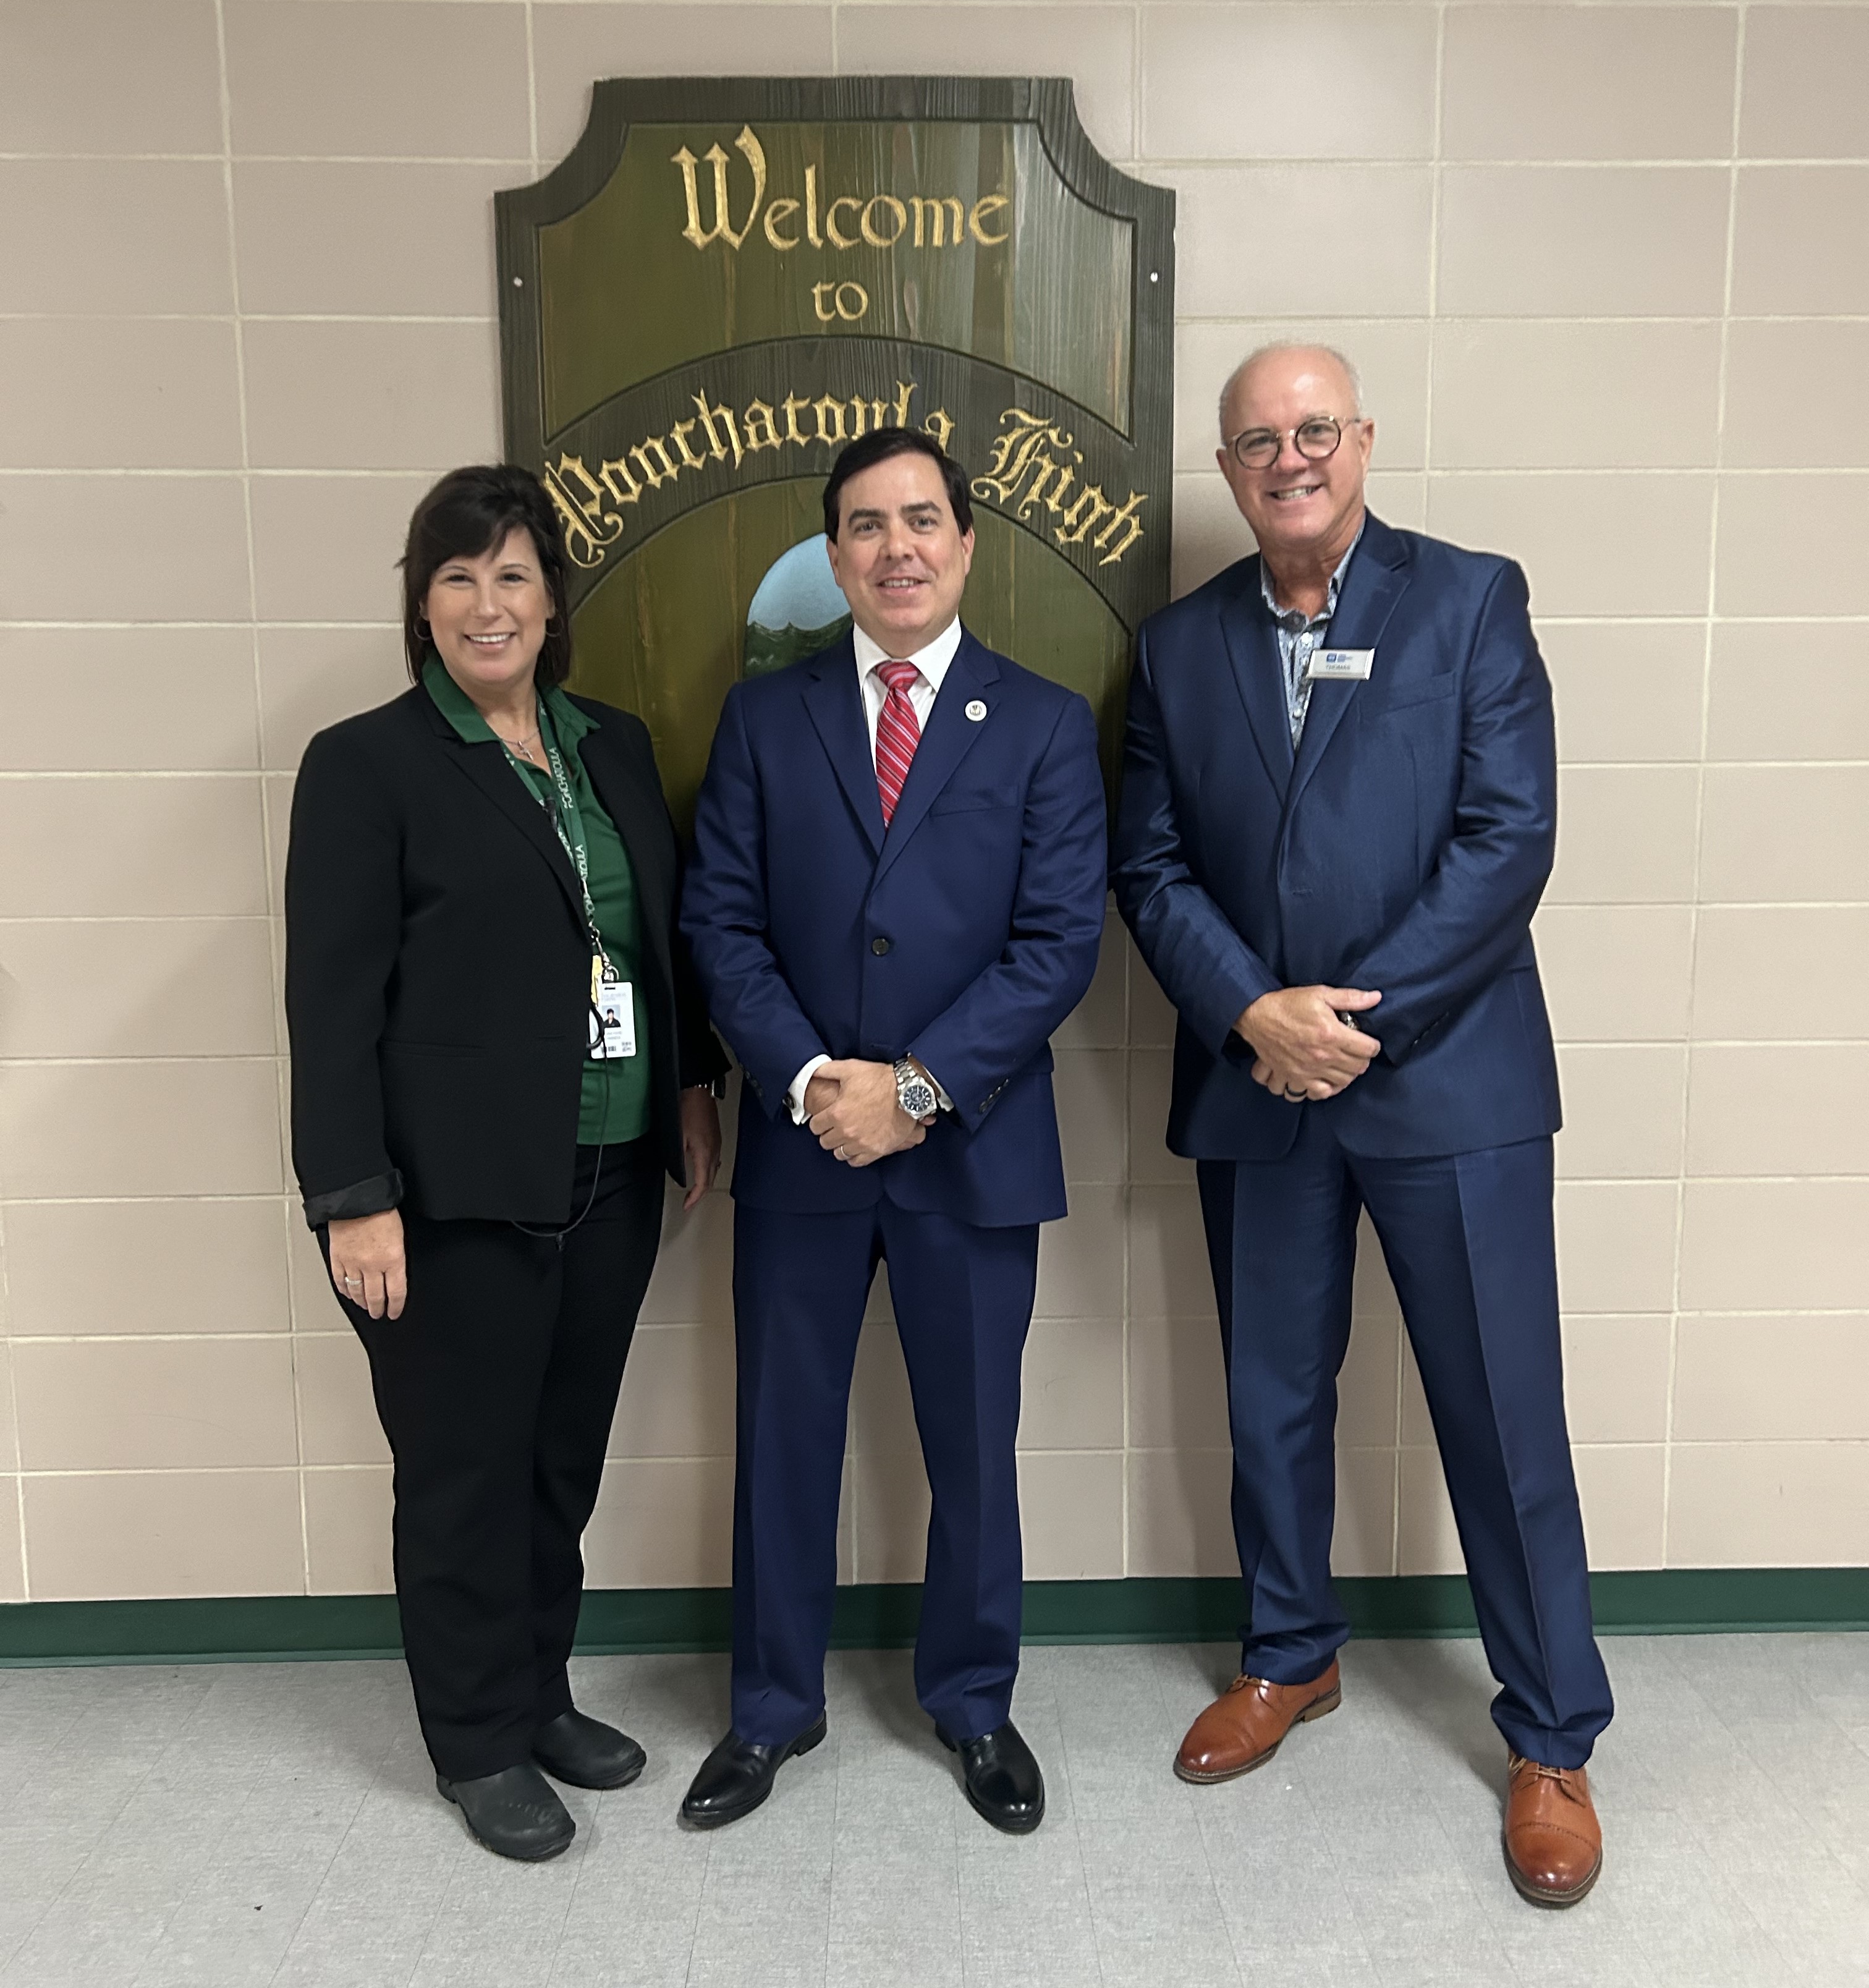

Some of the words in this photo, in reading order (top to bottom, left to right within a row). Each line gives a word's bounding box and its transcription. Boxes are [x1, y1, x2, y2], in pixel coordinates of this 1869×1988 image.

[671, 124, 1009, 250] Welcome
[811, 281, 868, 321] to
[971, 408, 1149, 566] High
